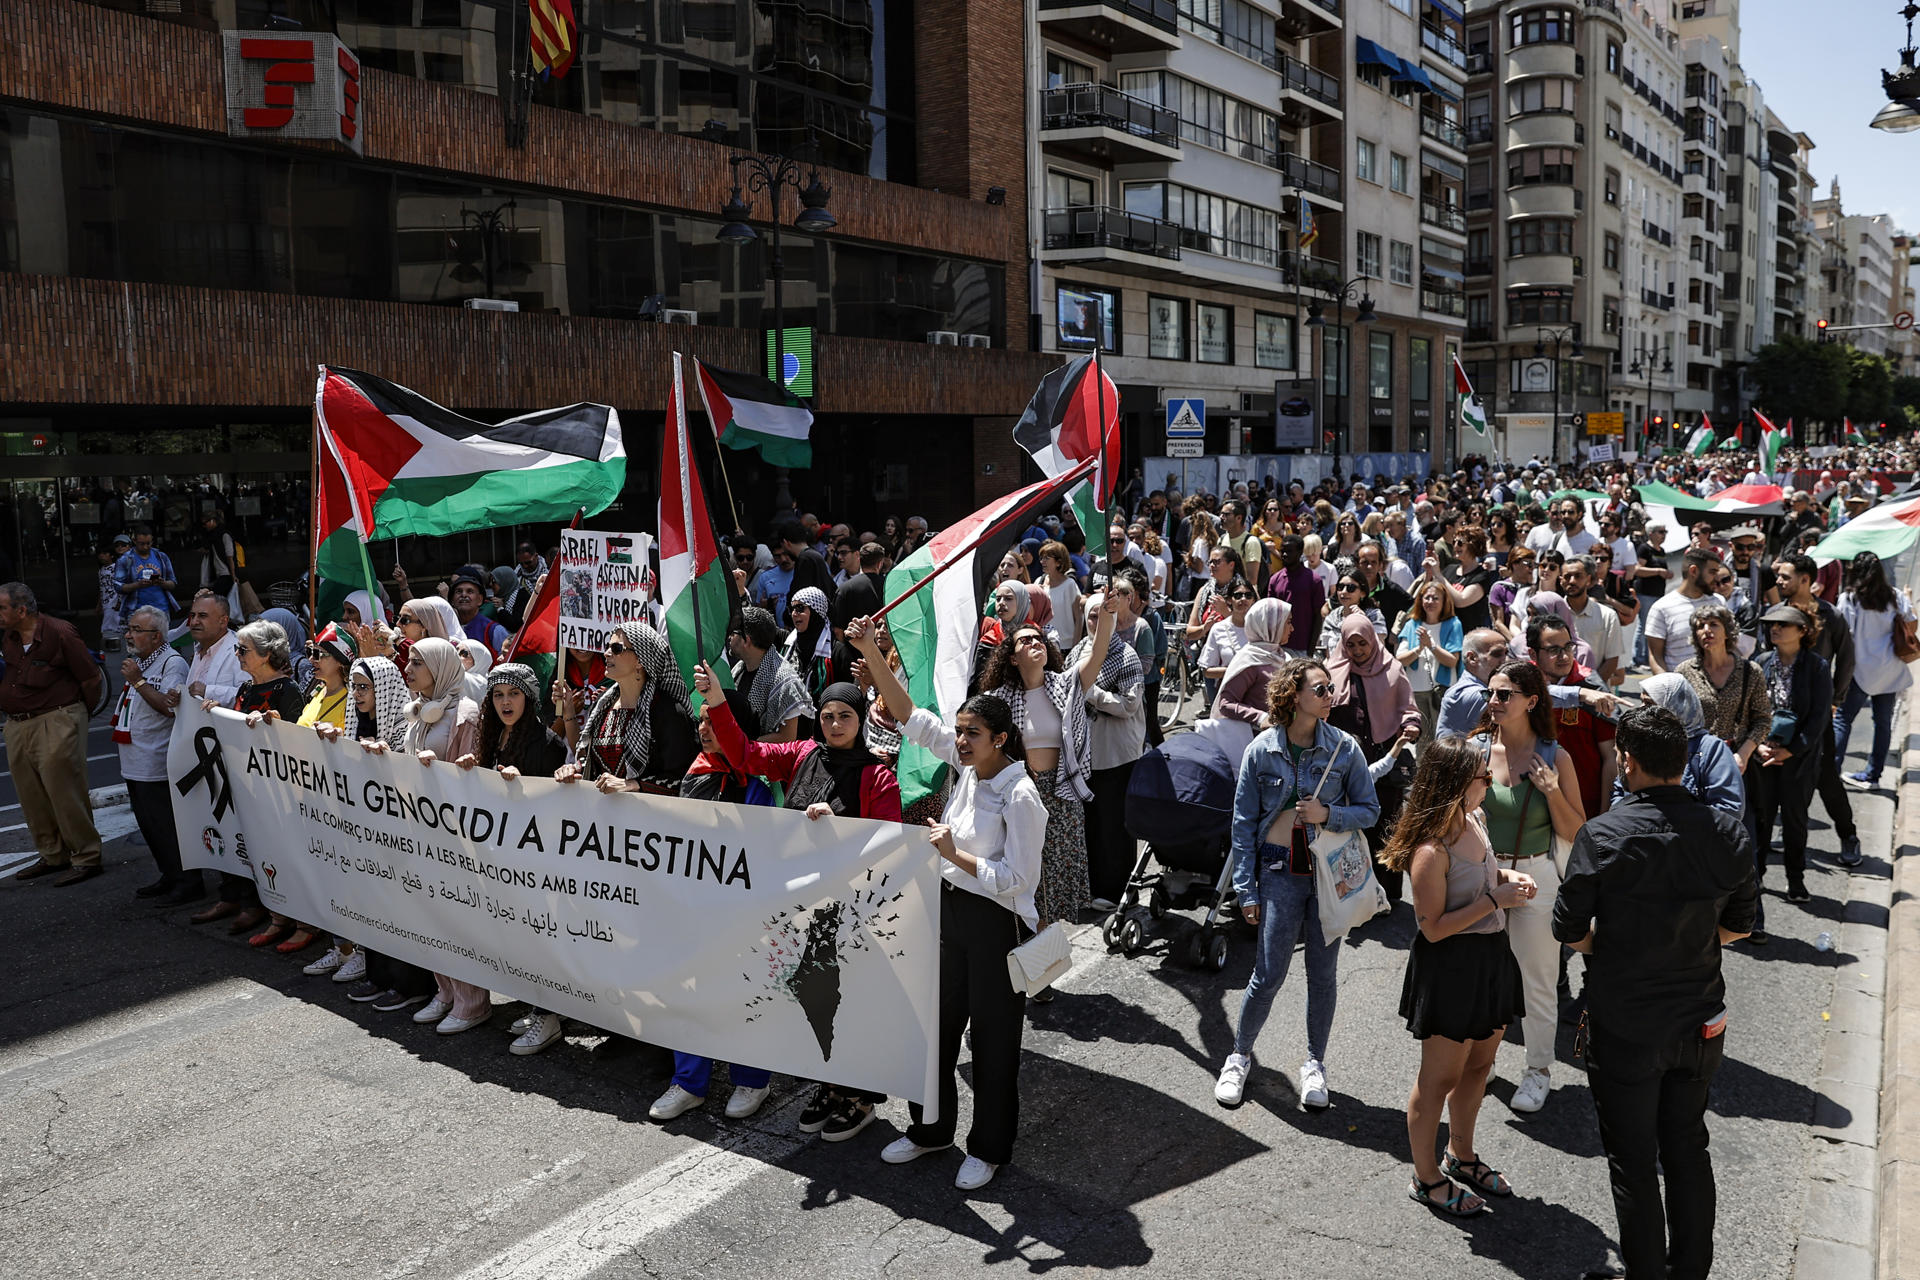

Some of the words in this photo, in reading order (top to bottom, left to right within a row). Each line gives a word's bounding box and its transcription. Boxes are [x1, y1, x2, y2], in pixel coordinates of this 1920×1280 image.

[561, 535, 599, 561] SRAEL
[597, 563, 648, 586] ASESINA
[561, 622, 612, 650] PATROC
[247, 746, 331, 797] ATUREM
[334, 770, 356, 807] EL
[363, 780, 509, 847] GENOCIDI
[517, 815, 545, 852] A
[559, 819, 752, 890] PALESTINA
[300, 802, 308, 817] FI
[310, 807, 322, 823] AL
[323, 812, 362, 843] COMERÇ
[364, 827, 414, 854] D'ARMES
[417, 841, 422, 856] I
[425, 845, 434, 860] A
[437, 846, 457, 867] LES
[458, 854, 536, 889] RELACIONS
[541, 874, 577, 895] AMB
[583, 880, 640, 906] ISRAEL
[308, 837, 338, 866] إسرائيل
[340, 855, 351, 874] مع
[355, 857, 397, 881] العلاقات
[401, 870, 423, 894] قطع
[428, 884, 435, 898] و
[440, 881, 481, 909] الأسلحة
[486, 896, 516, 924] تجارة
[521, 909, 558, 939] بإنهاء
[566, 919, 614, 943] نطالب
[330, 899, 499, 973] finalcomerciodearmasconisrael.org
[508, 960, 596, 1003] boicotisrael.net
